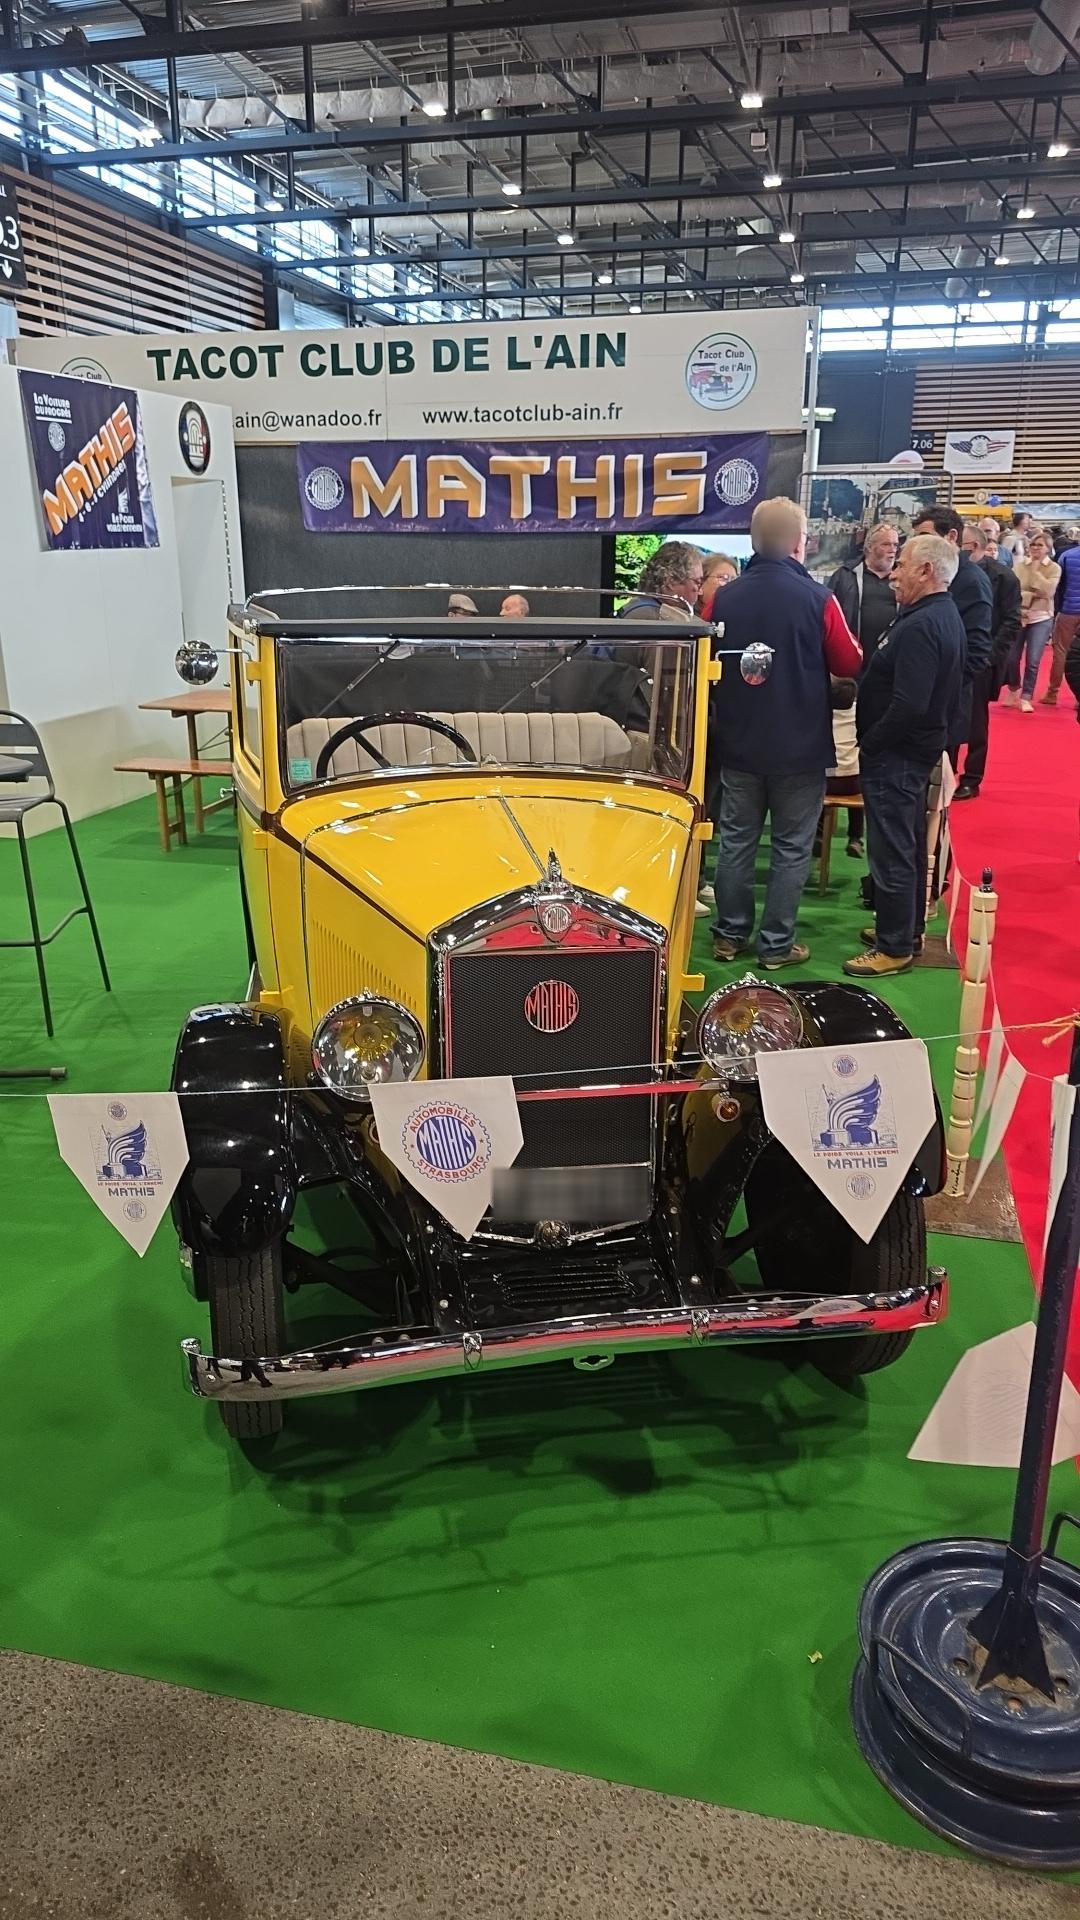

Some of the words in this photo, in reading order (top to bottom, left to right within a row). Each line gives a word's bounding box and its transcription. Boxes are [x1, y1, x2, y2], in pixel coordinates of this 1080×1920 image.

[147, 345, 284, 381] TACOT
[300, 341, 415, 378] CLUB
[432, 338, 490, 373] DE
[507, 332, 627, 371] L'AIN
[698, 350, 722, 359] Tacot
[725, 349, 745, 358] Club
[86, 371, 102, 380] Club
[719, 364, 730, 372] de
[232, 409, 382, 432] ain@wanadoo.fr
[423, 402, 623, 424] www.tacotclub-ain.fr
[912, 440, 933, 449] 7.06
[43, 401, 136, 536] MATHIS
[351, 451, 708, 519] MATHIS
[525, 981, 579, 1031] MATHIS
[409, 1106, 476, 1133] AUTOMOBILES
[417, 1116, 476, 1169] MATHIS
[417, 1155, 485, 1179] STRASBOURG
[827, 1157, 888, 1169] MATHIS
[108, 1187, 155, 1197] MATHIS
